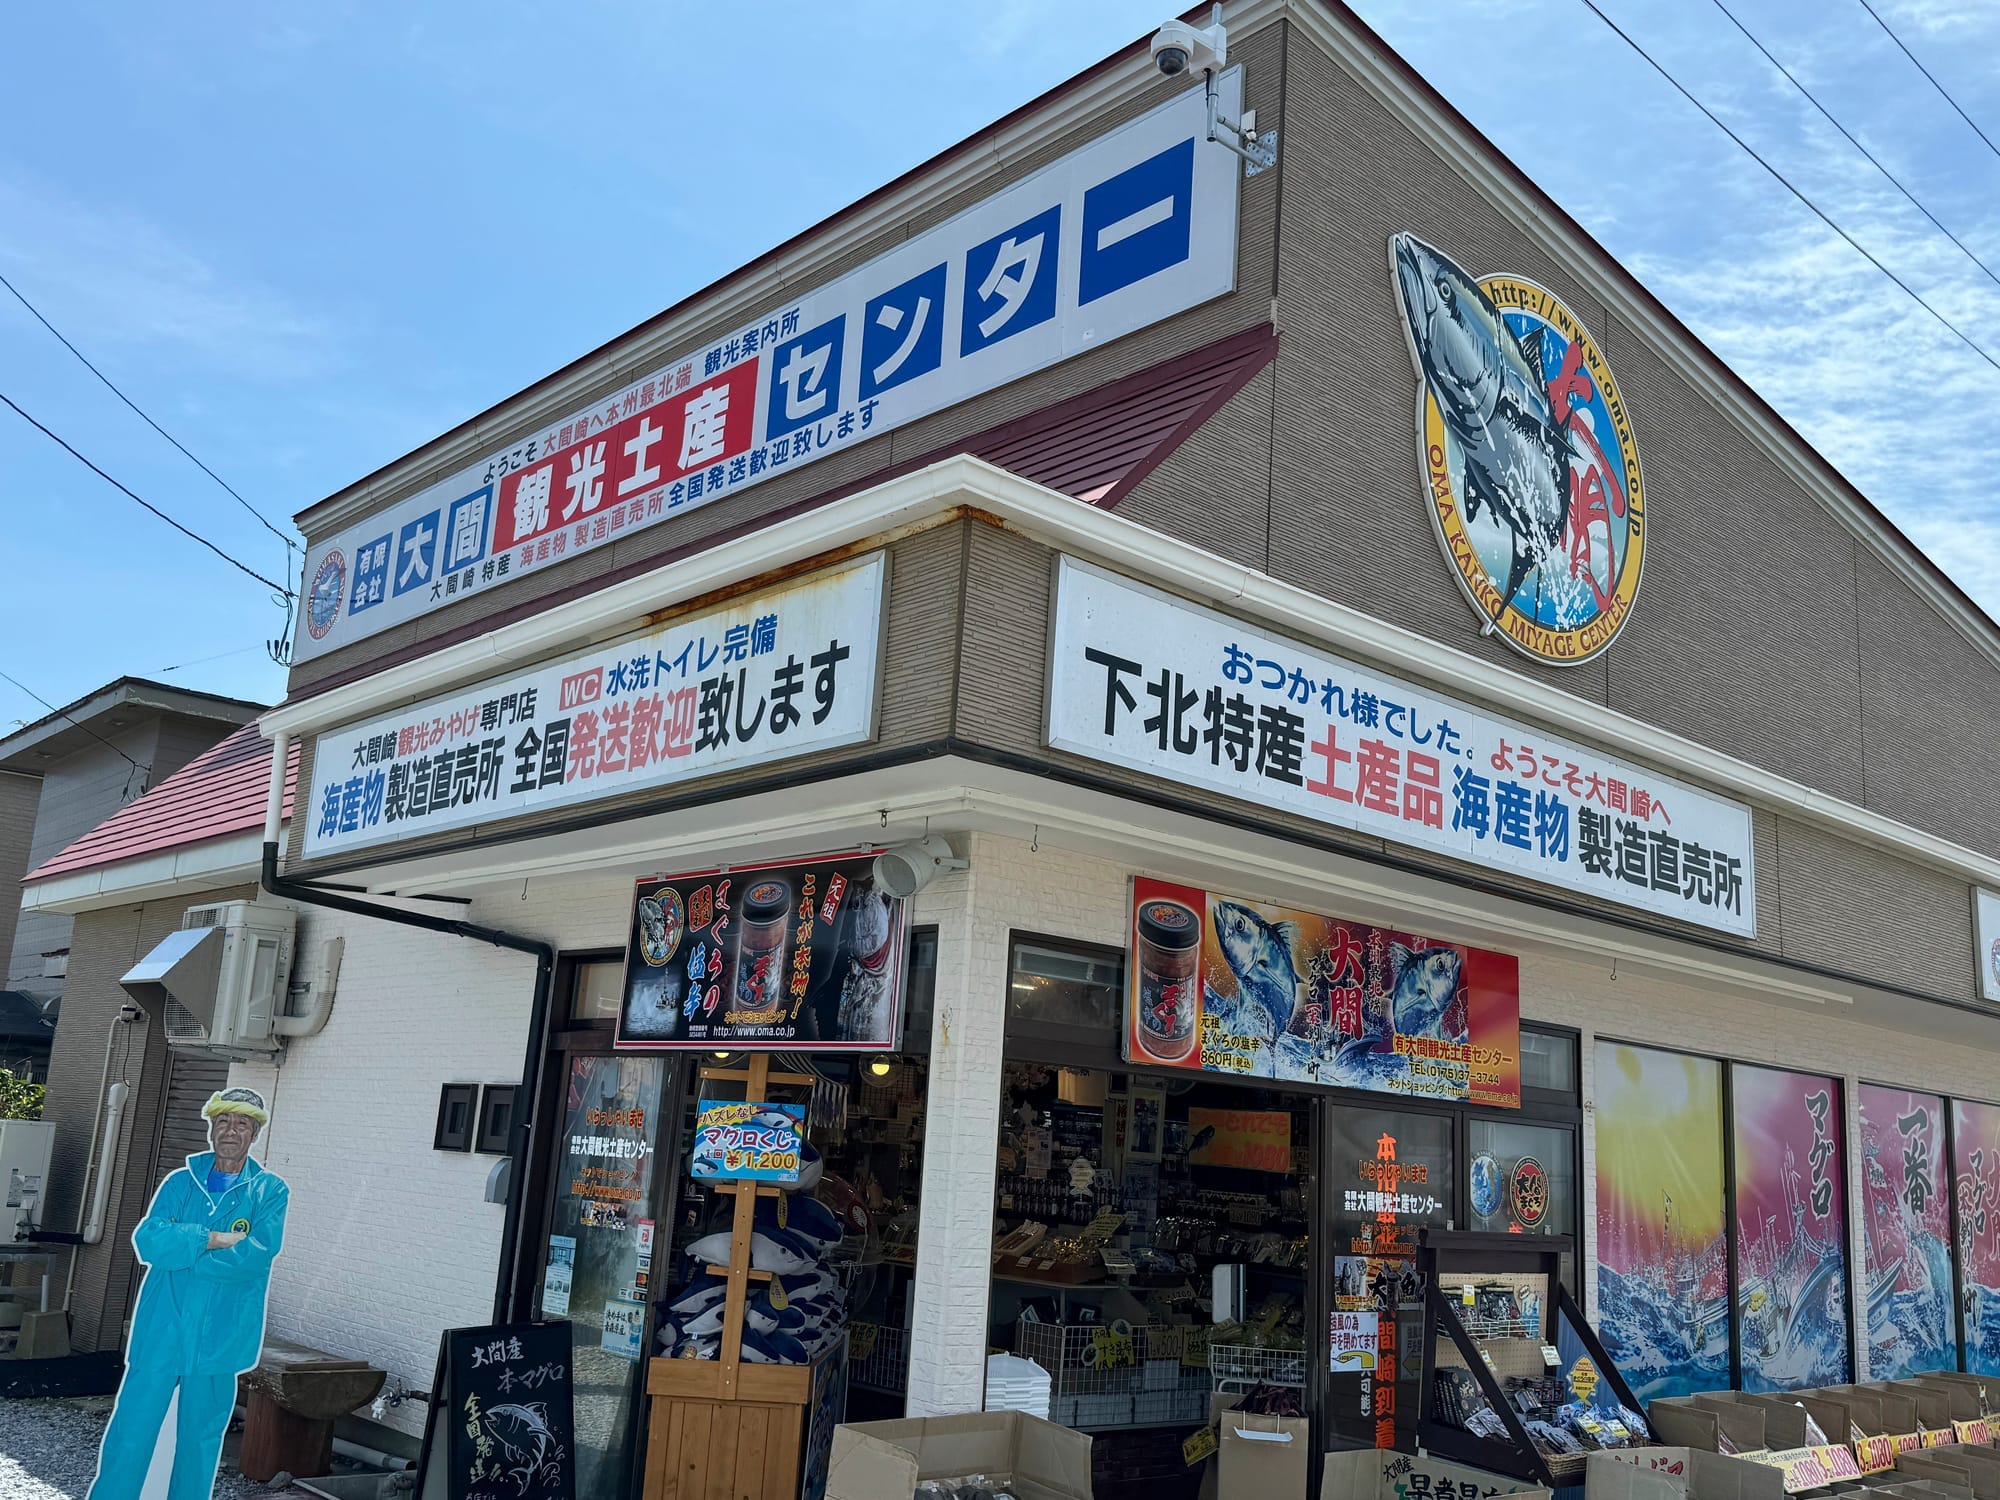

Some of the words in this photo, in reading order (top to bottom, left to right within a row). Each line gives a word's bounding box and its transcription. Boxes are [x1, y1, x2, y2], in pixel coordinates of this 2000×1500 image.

[400, 495, 487, 588] 大間
[513, 383, 729, 541] 観光土産
[780, 195, 1173, 420] センター
[483, 442, 537, 484] ようこそ
[705, 307, 800, 377] 観光案内所
[1488, 282, 1644, 537] http://www.oma.co.jp
[431, 568, 474, 602] 大間崎
[482, 554, 510, 583] 特産
[520, 533, 566, 568] 海産物
[575, 492, 664, 546] 製造直売所
[668, 400, 879, 508] 全国発送歓迎致します
[1429, 445, 1454, 522] OMA
[1450, 531, 1504, 621] KANKO
[1509, 613, 1576, 657] MIYAGE
[1580, 593, 1629, 651] CENTER
[351, 688, 537, 771] 大間崎観光みやげ専門店
[564, 673, 600, 702] WC
[606, 613, 778, 697] 水洗トイレ完備
[318, 768, 385, 839] 海産物
[385, 736, 506, 823] 製造直売所
[510, 639, 850, 794] 全国発送歓迎致します
[1221, 642, 1473, 760] おつかれ様でした。
[1490, 738, 1672, 826] ようこそ大間崎へ
[1085, 646, 1443, 830] 下北特産土産品
[1452, 763, 1570, 863] 海産物
[1578, 805, 1743, 917] 製造直売所
[823, 879, 842, 921] 元祖
[702, 879, 731, 1018] まぐろの
[1327, 927, 1365, 1042] 大間
[1368, 928, 1384, 1017] 本州最北端
[713, 1025, 796, 1039] http://www.oma.co.jp
[1200, 1013, 1220, 1029] 元祖
[1201, 1030, 1261, 1052] まぐろの塩辛
[1394, 1035, 1513, 1067] 有大間観光土産センター
[1408, 1062, 1500, 1086] TEL(0175)37-3744
[585, 1106, 645, 1128] いらっしゃいませ
[702, 1104, 758, 1123] ハズレなし
[581, 1136, 654, 1159] 大間観光土産センター
[704, 1127, 792, 1149] マグロくじ
[705, 1149, 723, 1159] 1回
[1806, 1089, 1835, 1220] マグロ
[1359, 1160, 1429, 1184] いらっしゃいませ
[1897, 1106, 1934, 1217] 一番
[1357, 1190, 1443, 1214] 大間観光土産センター
[1519, 1196, 1542, 1210] まぐろ
[1968, 1147, 1987, 1236] マグロ
[471, 1336, 525, 1368] 大間産
[1330, 1332, 1378, 1351] 戸を閉めてます
[497, 1361, 566, 1395] 本マグロ
[1383, 1455, 1414, 1483] 大間産
